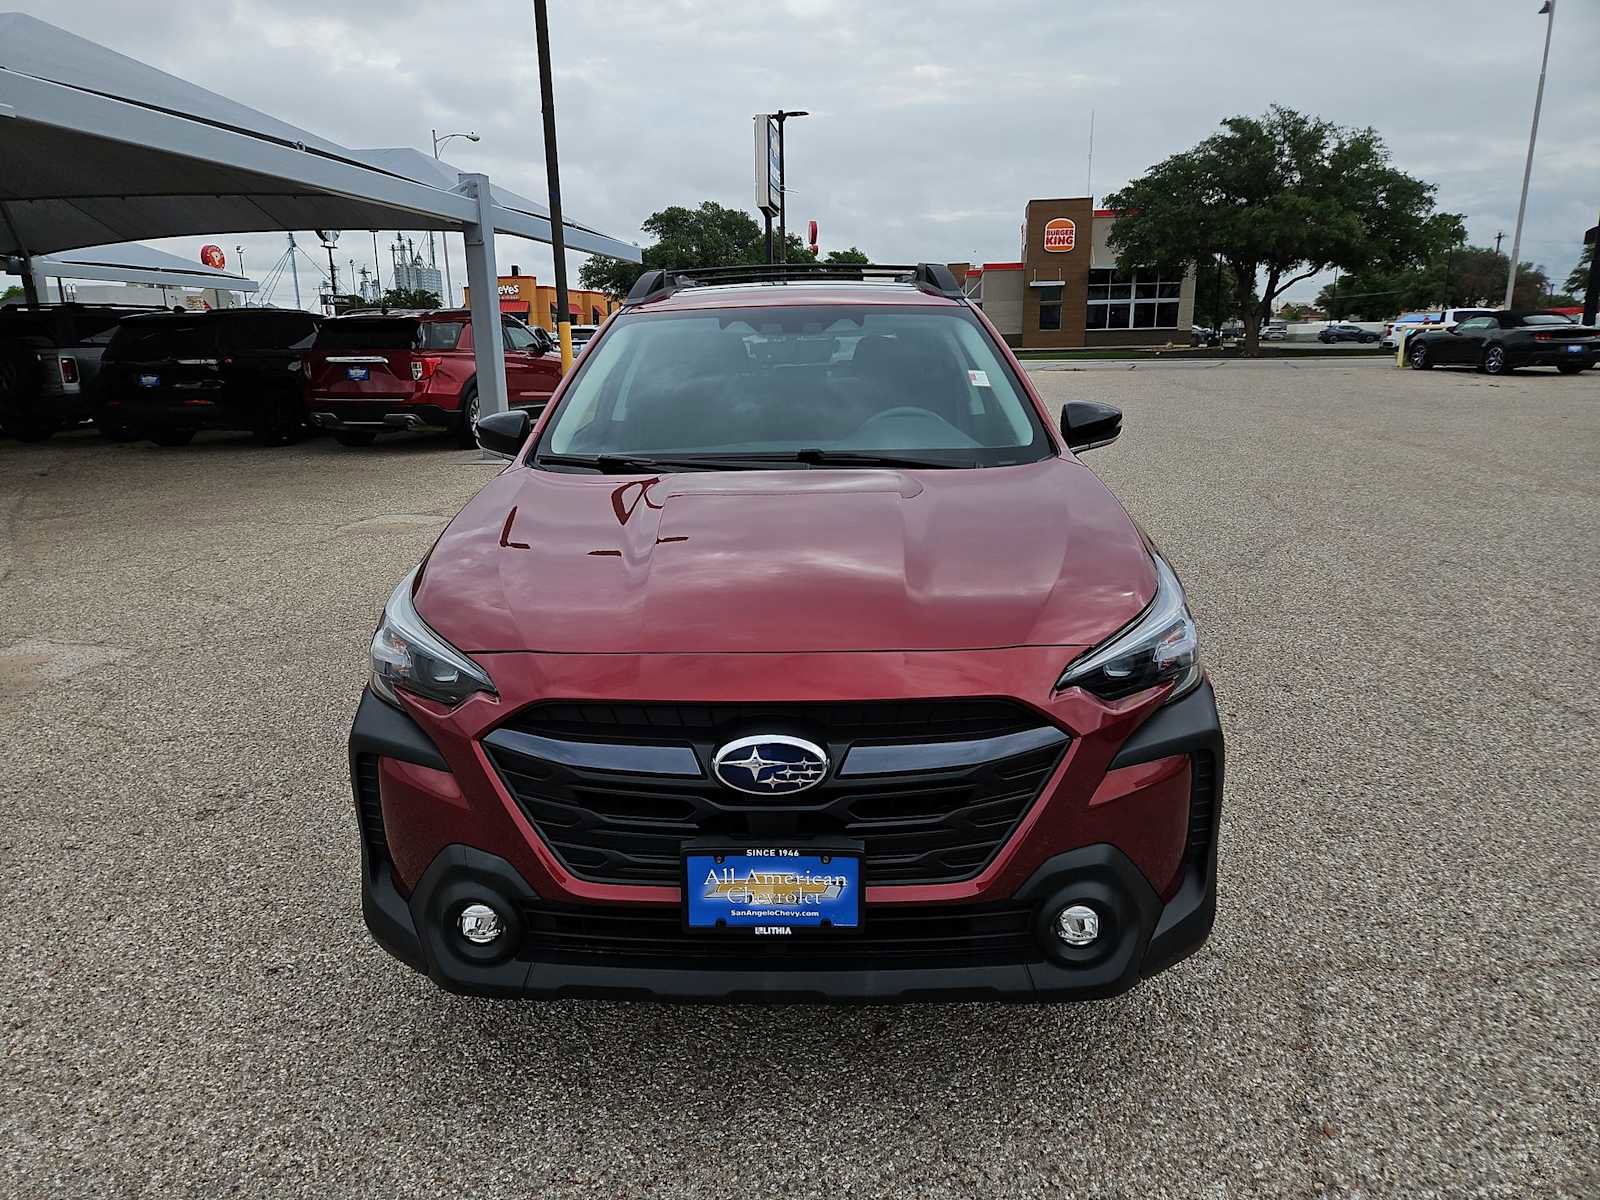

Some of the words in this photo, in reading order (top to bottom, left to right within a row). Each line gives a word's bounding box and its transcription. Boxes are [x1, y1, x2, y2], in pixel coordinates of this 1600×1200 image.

[1045, 236, 1074, 245] KING
[746, 849, 776, 857] SINCE
[778, 849, 800, 857] 1946
[704, 867, 736, 885] All
[744, 868, 848, 886] American
[727, 886, 821, 904] Chevrolet
[730, 909, 820, 918] SanAngeloChevy.com
